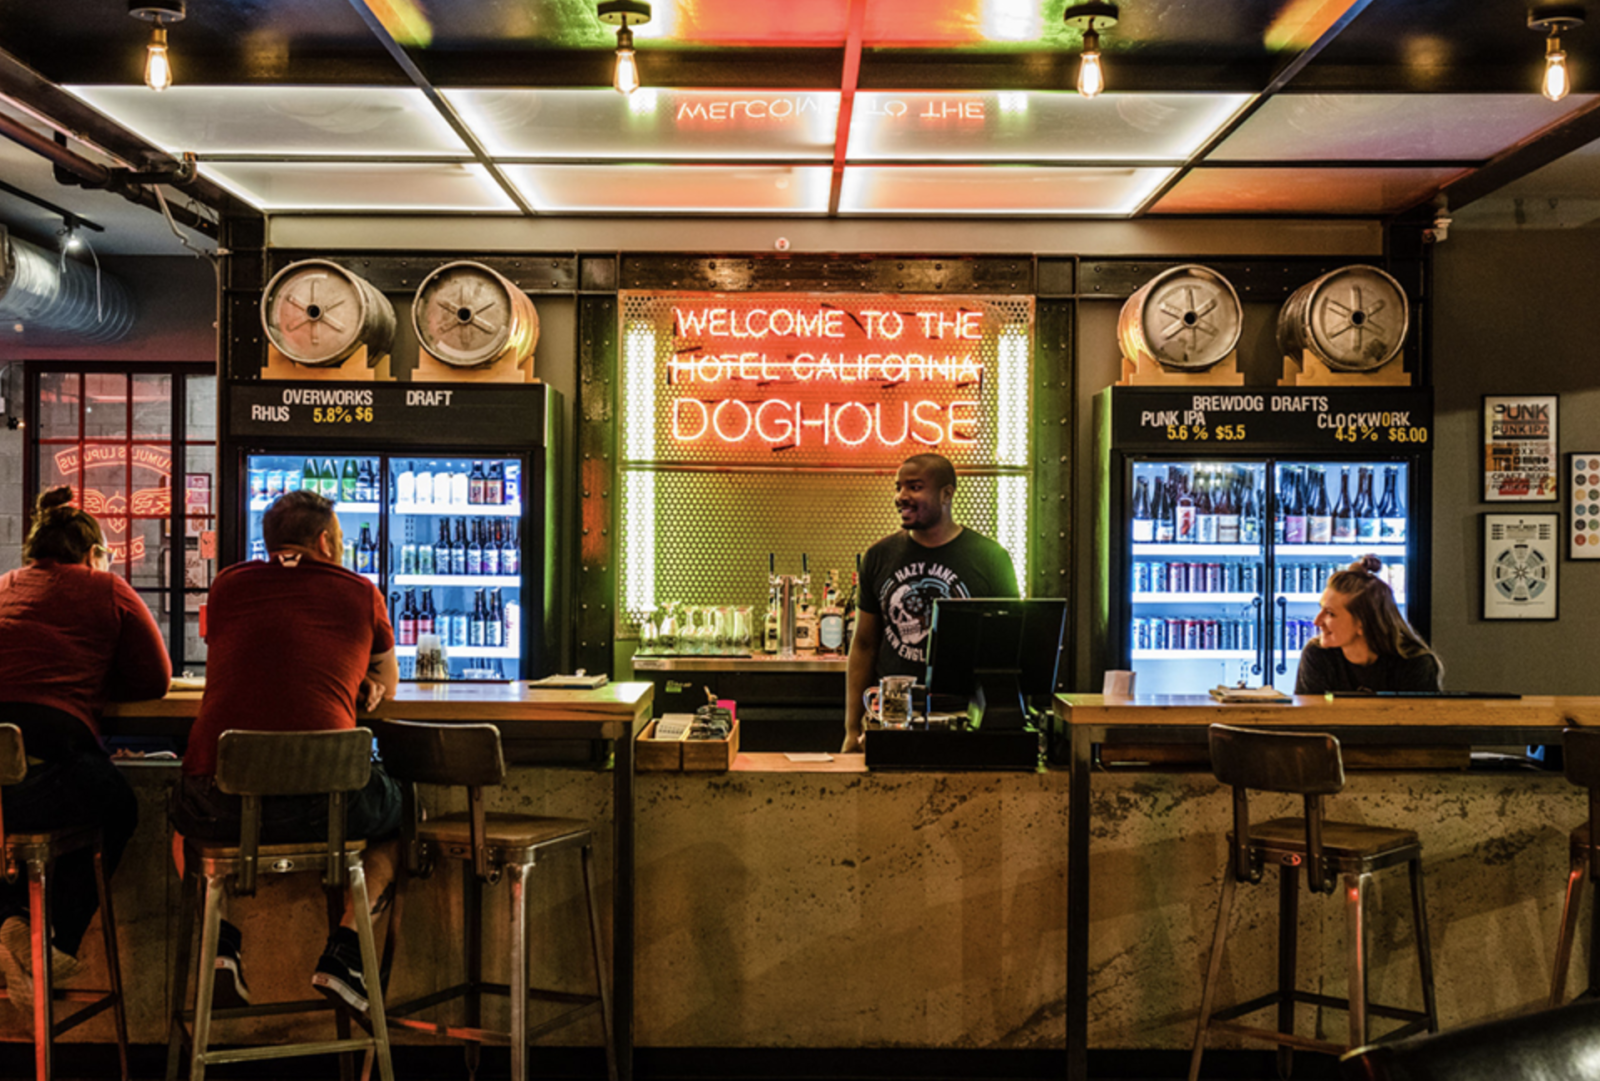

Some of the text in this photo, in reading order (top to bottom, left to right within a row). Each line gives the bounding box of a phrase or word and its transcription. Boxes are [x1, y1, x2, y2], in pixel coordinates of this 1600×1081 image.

[675, 308, 984, 339] WELCOME TO THE
[670, 353, 981, 383] HOTEL CALIFORNIA
[282, 389, 453, 406] OVERWORKS DRAFT
[1192, 395, 1329, 412] BREWDOG DRAFTS
[251, 404, 374, 423] RHUS 5.8% $6
[1140, 410, 1207, 427] PUNK IPA
[1316, 411, 1411, 429] CLOCKWORK
[1492, 403, 1549, 420] PUNK
[672, 398, 979, 446] DOGHOUSE
[1166, 424, 1246, 440] 5.6 % $5.5
[1361, 425, 1379, 441] %
[1387, 427, 1428, 443] $6.00
[894, 562, 958, 585] HAZY JANE
[884, 625, 926, 662] NEW ENGL
